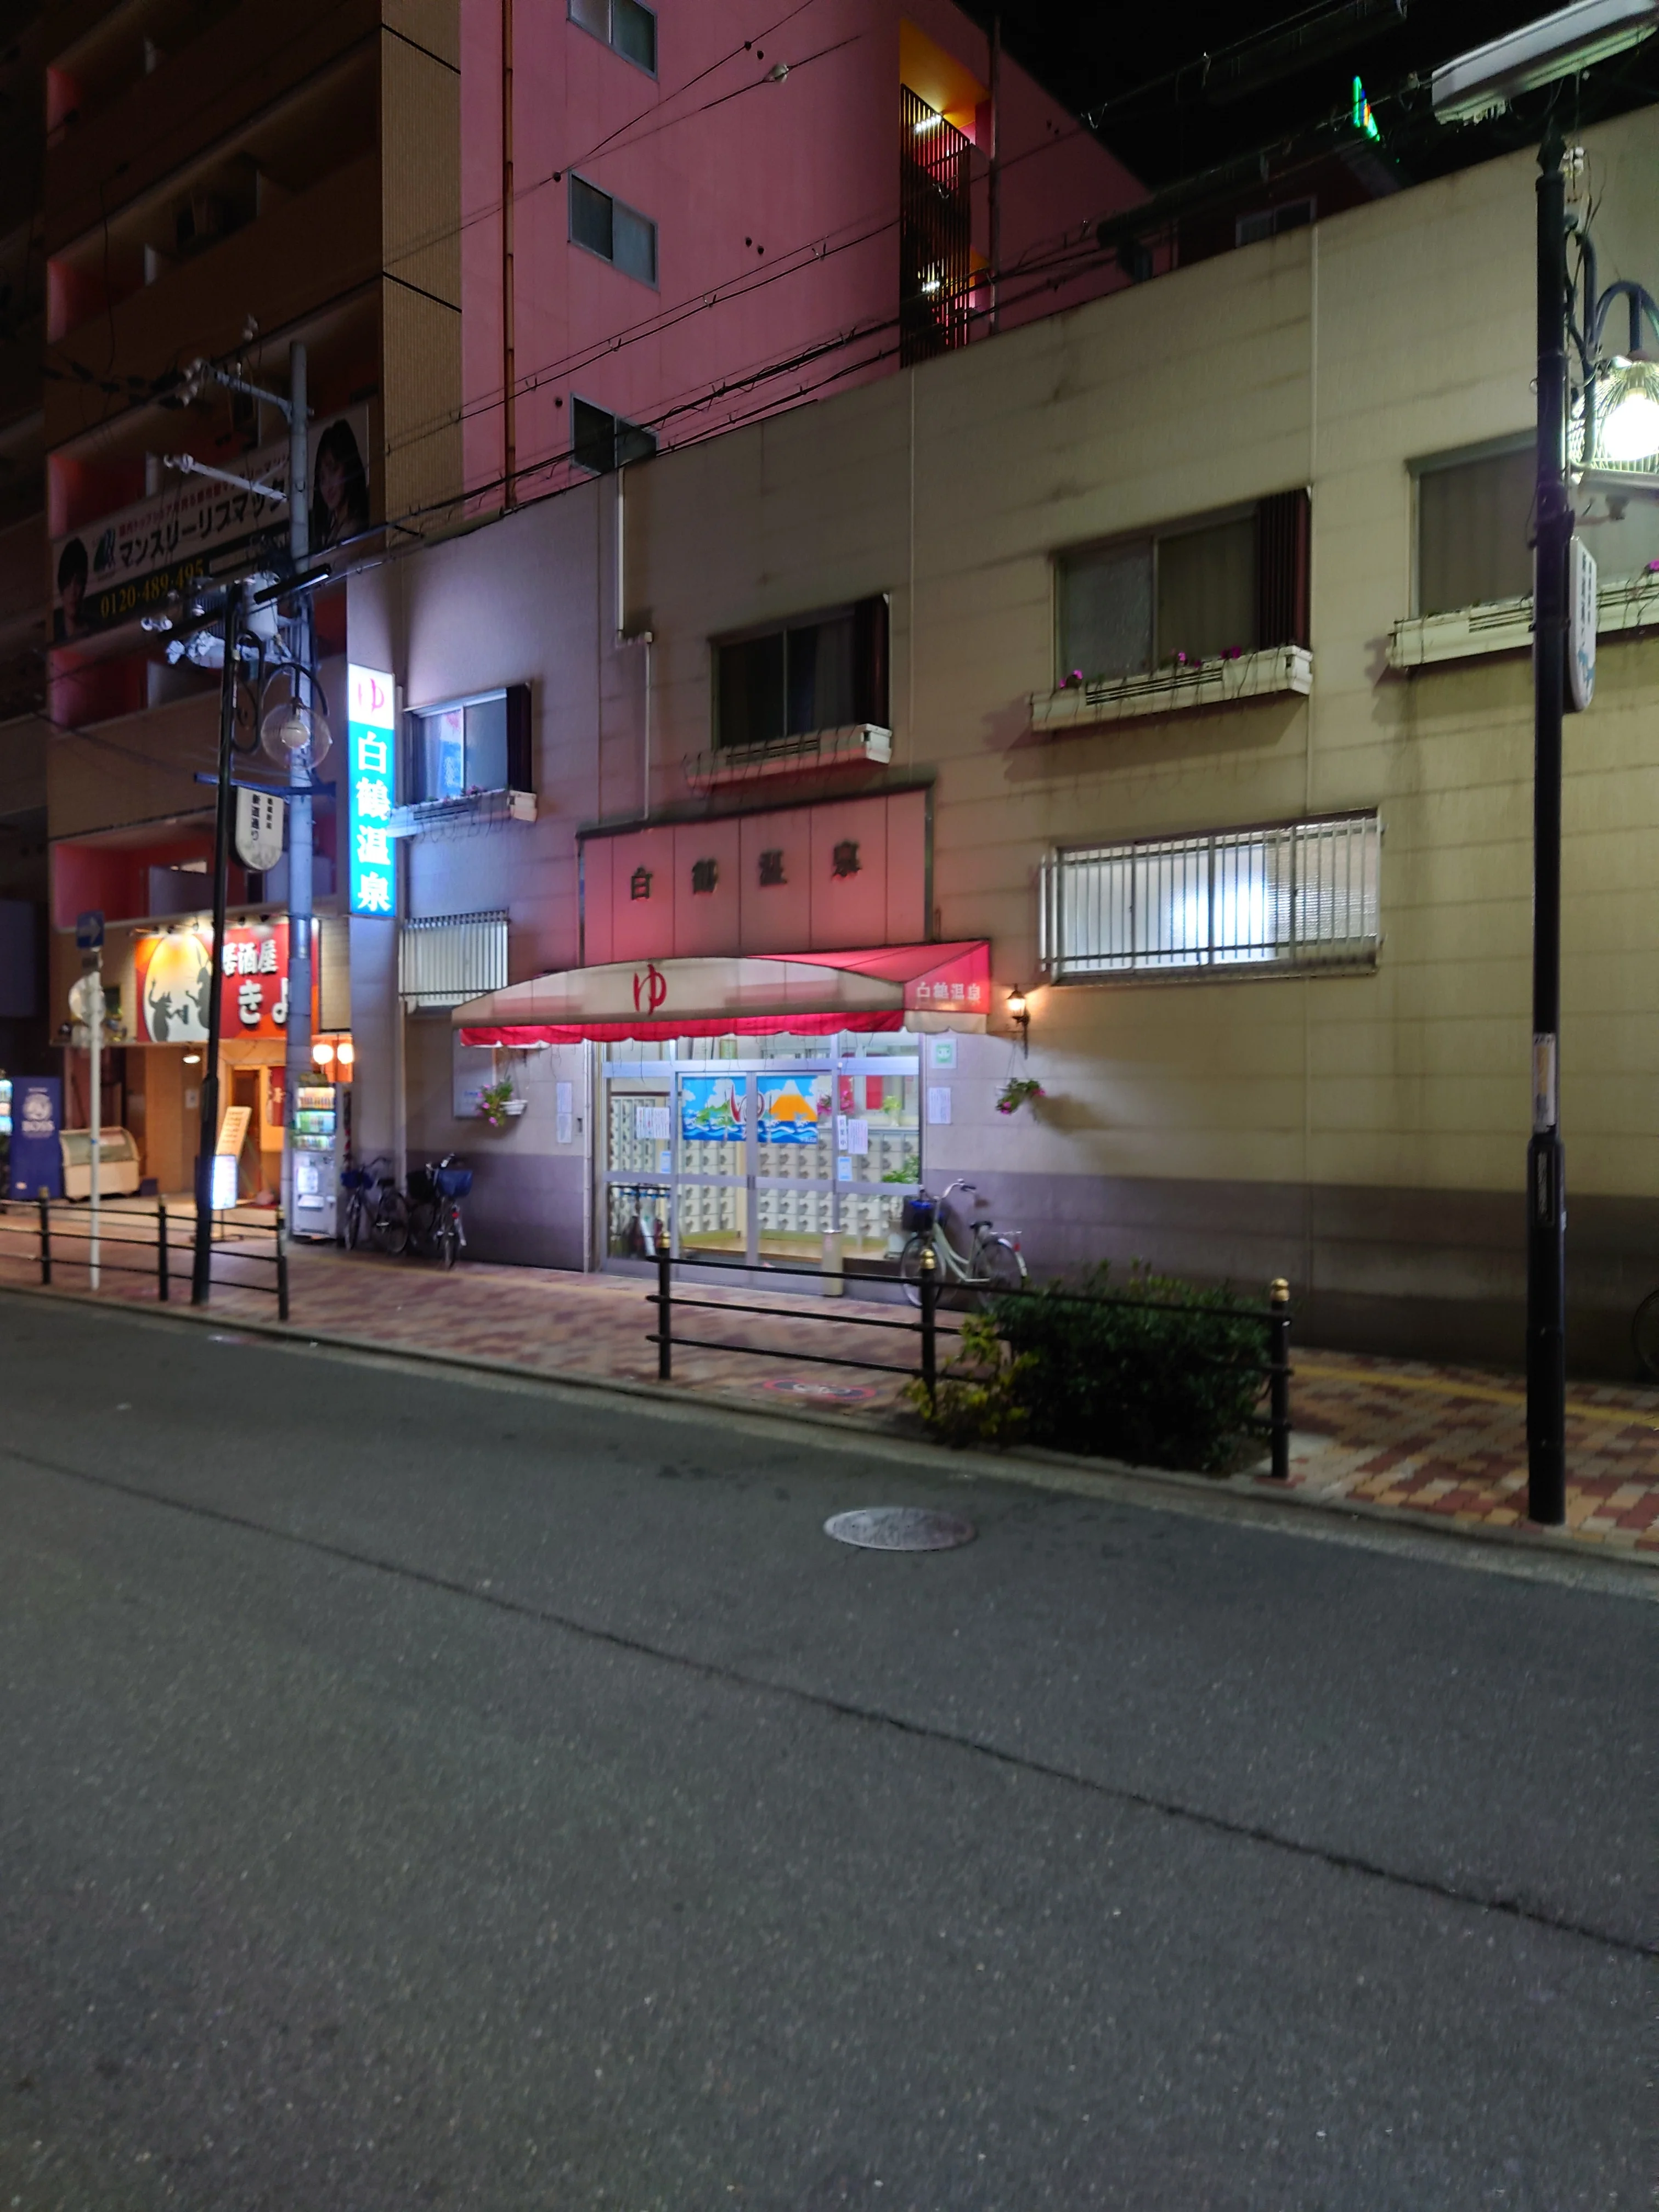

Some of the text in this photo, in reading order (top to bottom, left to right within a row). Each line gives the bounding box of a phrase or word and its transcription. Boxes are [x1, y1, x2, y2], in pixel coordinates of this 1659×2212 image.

[358, 678, 385, 715] ゆ
[356, 730, 391, 912] 白鶴温泉
[633, 963, 667, 1016] ゆ
[917, 982, 981, 1002] 白鶴温泉
